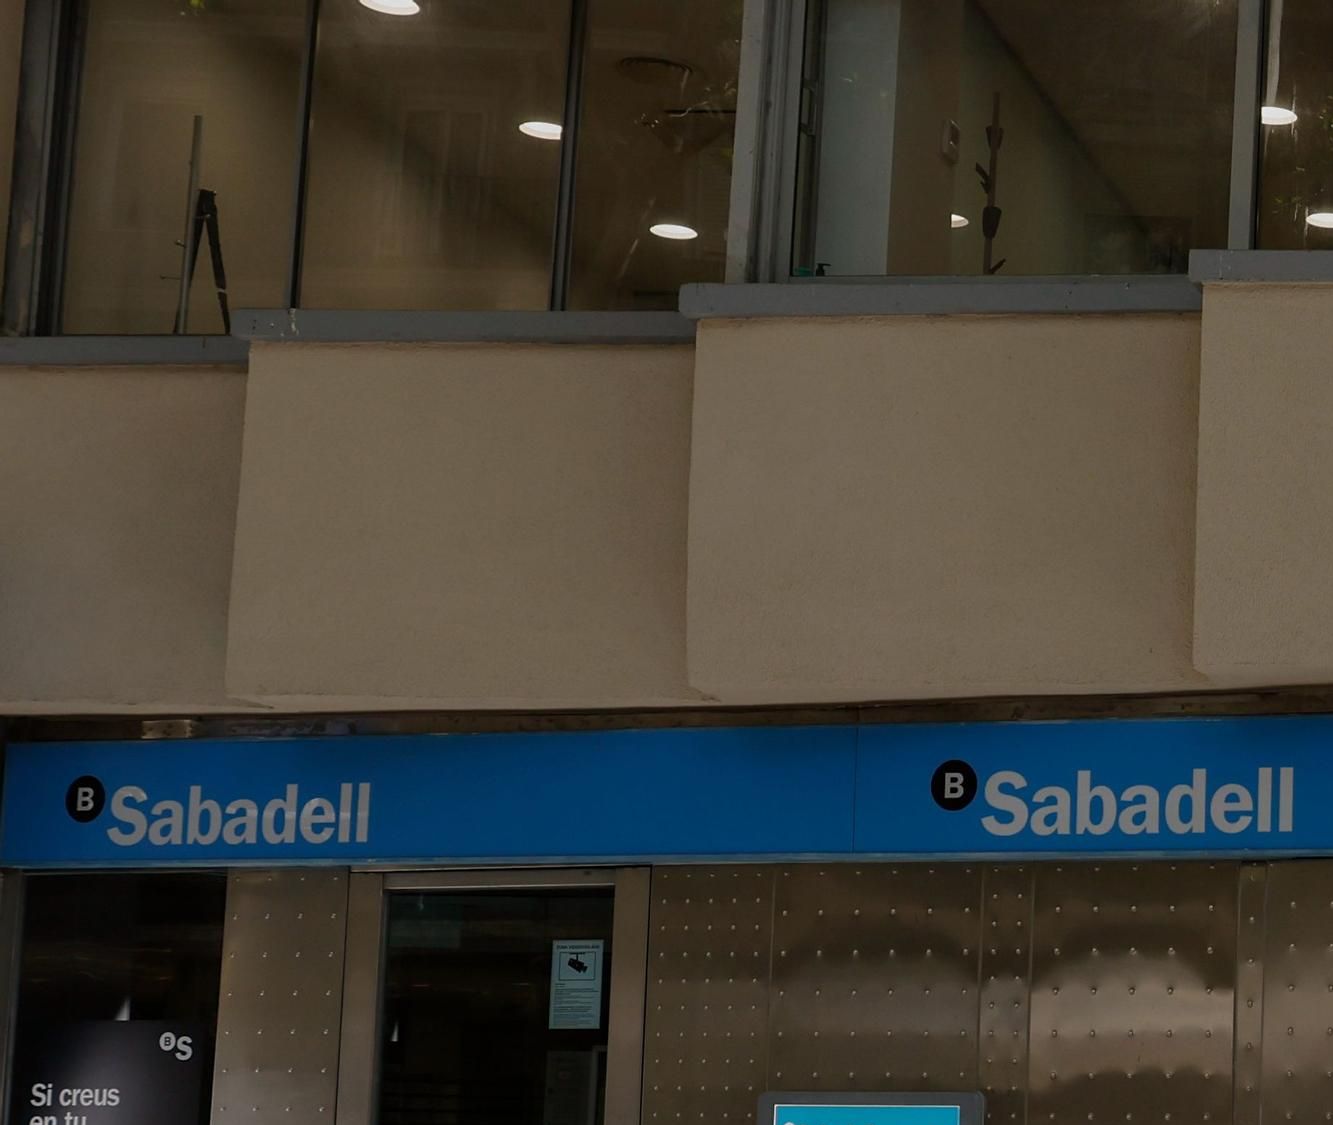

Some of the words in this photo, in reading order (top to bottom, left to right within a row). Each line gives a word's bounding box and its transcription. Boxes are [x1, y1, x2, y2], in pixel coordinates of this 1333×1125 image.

[107, 782, 370, 845] Sabadell
[981, 767, 1293, 835] Sabadell
[31, 1083, 52, 1105] Si
[59, 1088, 119, 1106] creus
